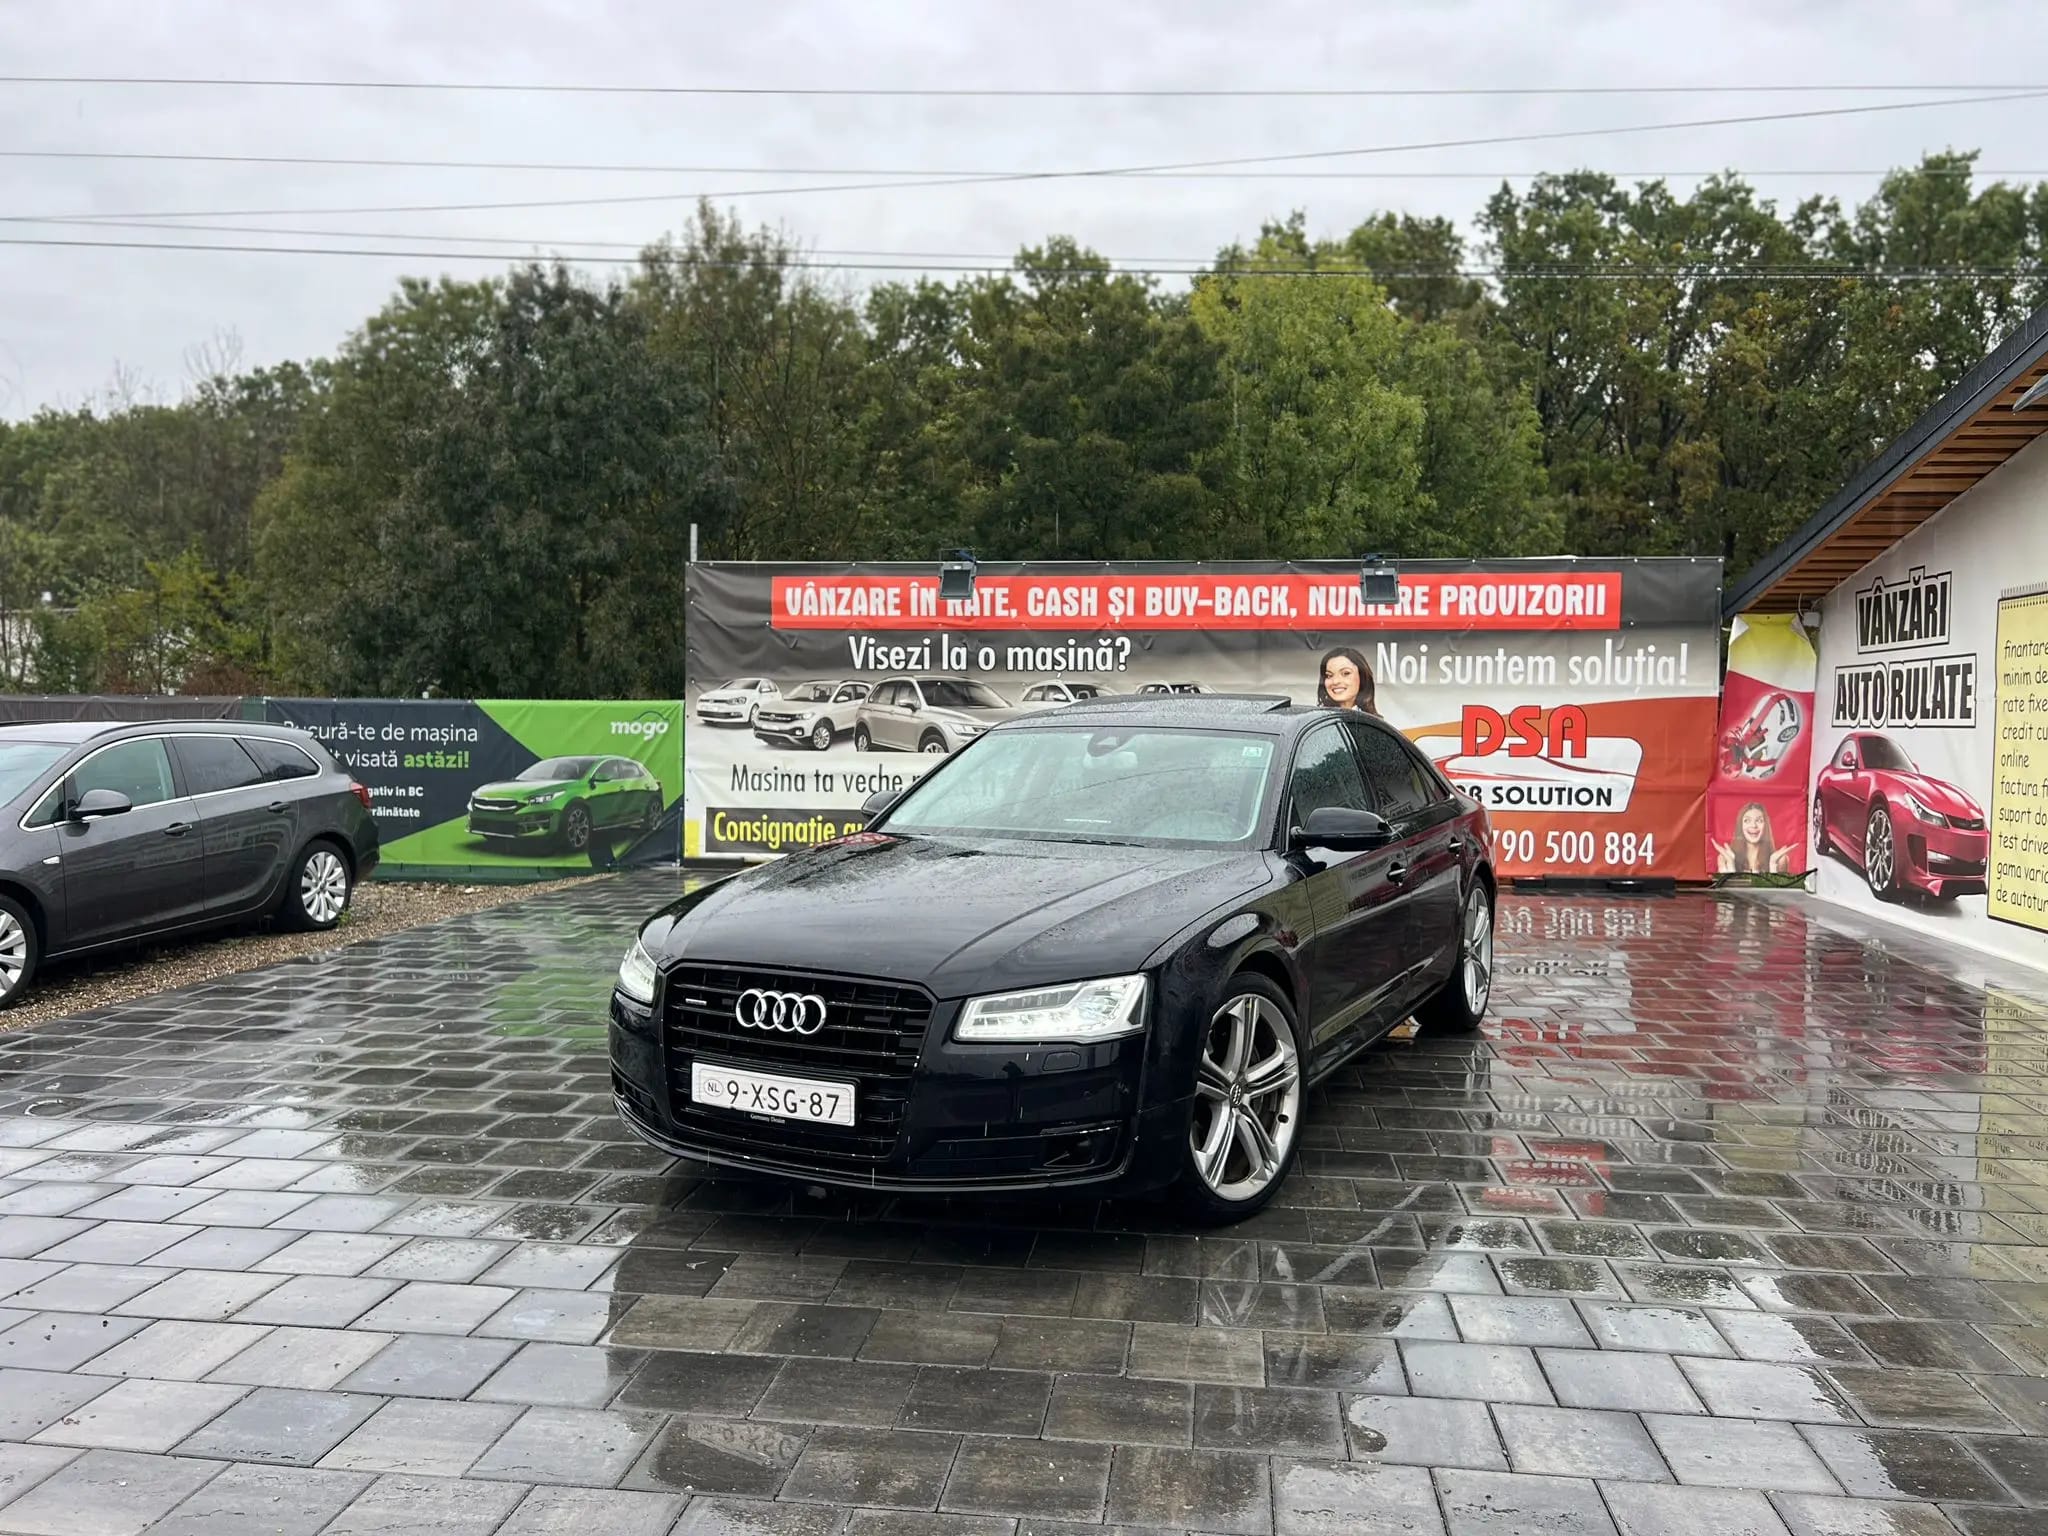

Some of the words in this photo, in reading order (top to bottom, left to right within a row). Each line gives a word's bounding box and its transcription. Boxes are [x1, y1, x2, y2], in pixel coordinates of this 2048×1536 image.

[785, 581, 901, 617] VÂNZARE
[910, 581, 937, 617] ÎN
[1027, 586, 1098, 616] CASH
[1108, 586, 1135, 623] ȘI
[1145, 585, 1297, 618] BUY-BACK,
[1440, 584, 1606, 616] PROVIZORII
[1859, 575, 1948, 646] VÂNZĂRI
[849, 636, 931, 670] Visezi
[942, 634, 967, 670] la
[978, 650, 996, 670] o
[1007, 637, 1131, 678] mașină?
[1376, 642, 1428, 685] Noi
[1439, 648, 1556, 685] suntem
[1568, 639, 1688, 693] soluția!
[2003, 667, 2032, 686] minim
[2035, 665, 2048, 684] de
[1835, 670, 1885, 721] AUTO
[1890, 663, 1973, 721] RULATE
[2003, 696, 2025, 712] rate
[2028, 693, 2048, 713] fixe
[381, 723, 405, 741] de
[411, 724, 478, 746] mașina
[610, 720, 669, 741] mogo
[1461, 704, 1587, 758] DSA
[2002, 721, 2033, 741] credit
[346, 751, 398, 768] visată
[404, 751, 470, 768] astăzi!
[2000, 749, 2029, 768] online
[731, 764, 806, 793] Masina
[814, 769, 834, 793] ta
[843, 764, 903, 793] veche
[2001, 775, 2038, 797] factura
[408, 786, 424, 797] BC
[1491, 786, 1612, 807] SOLUTION
[1999, 807, 2031, 828] suport
[714, 811, 836, 849] Consignație
[1544, 831, 1594, 864] 500
[1604, 832, 1654, 865] 884
[1999, 832, 2018, 850] test
[2021, 833, 2048, 855] drive
[1996, 862, 2021, 880] gama
[1996, 883, 2007, 902] de
[707, 1082, 720, 1093] NL
[727, 1080, 839, 1119] 9-XSG-87
